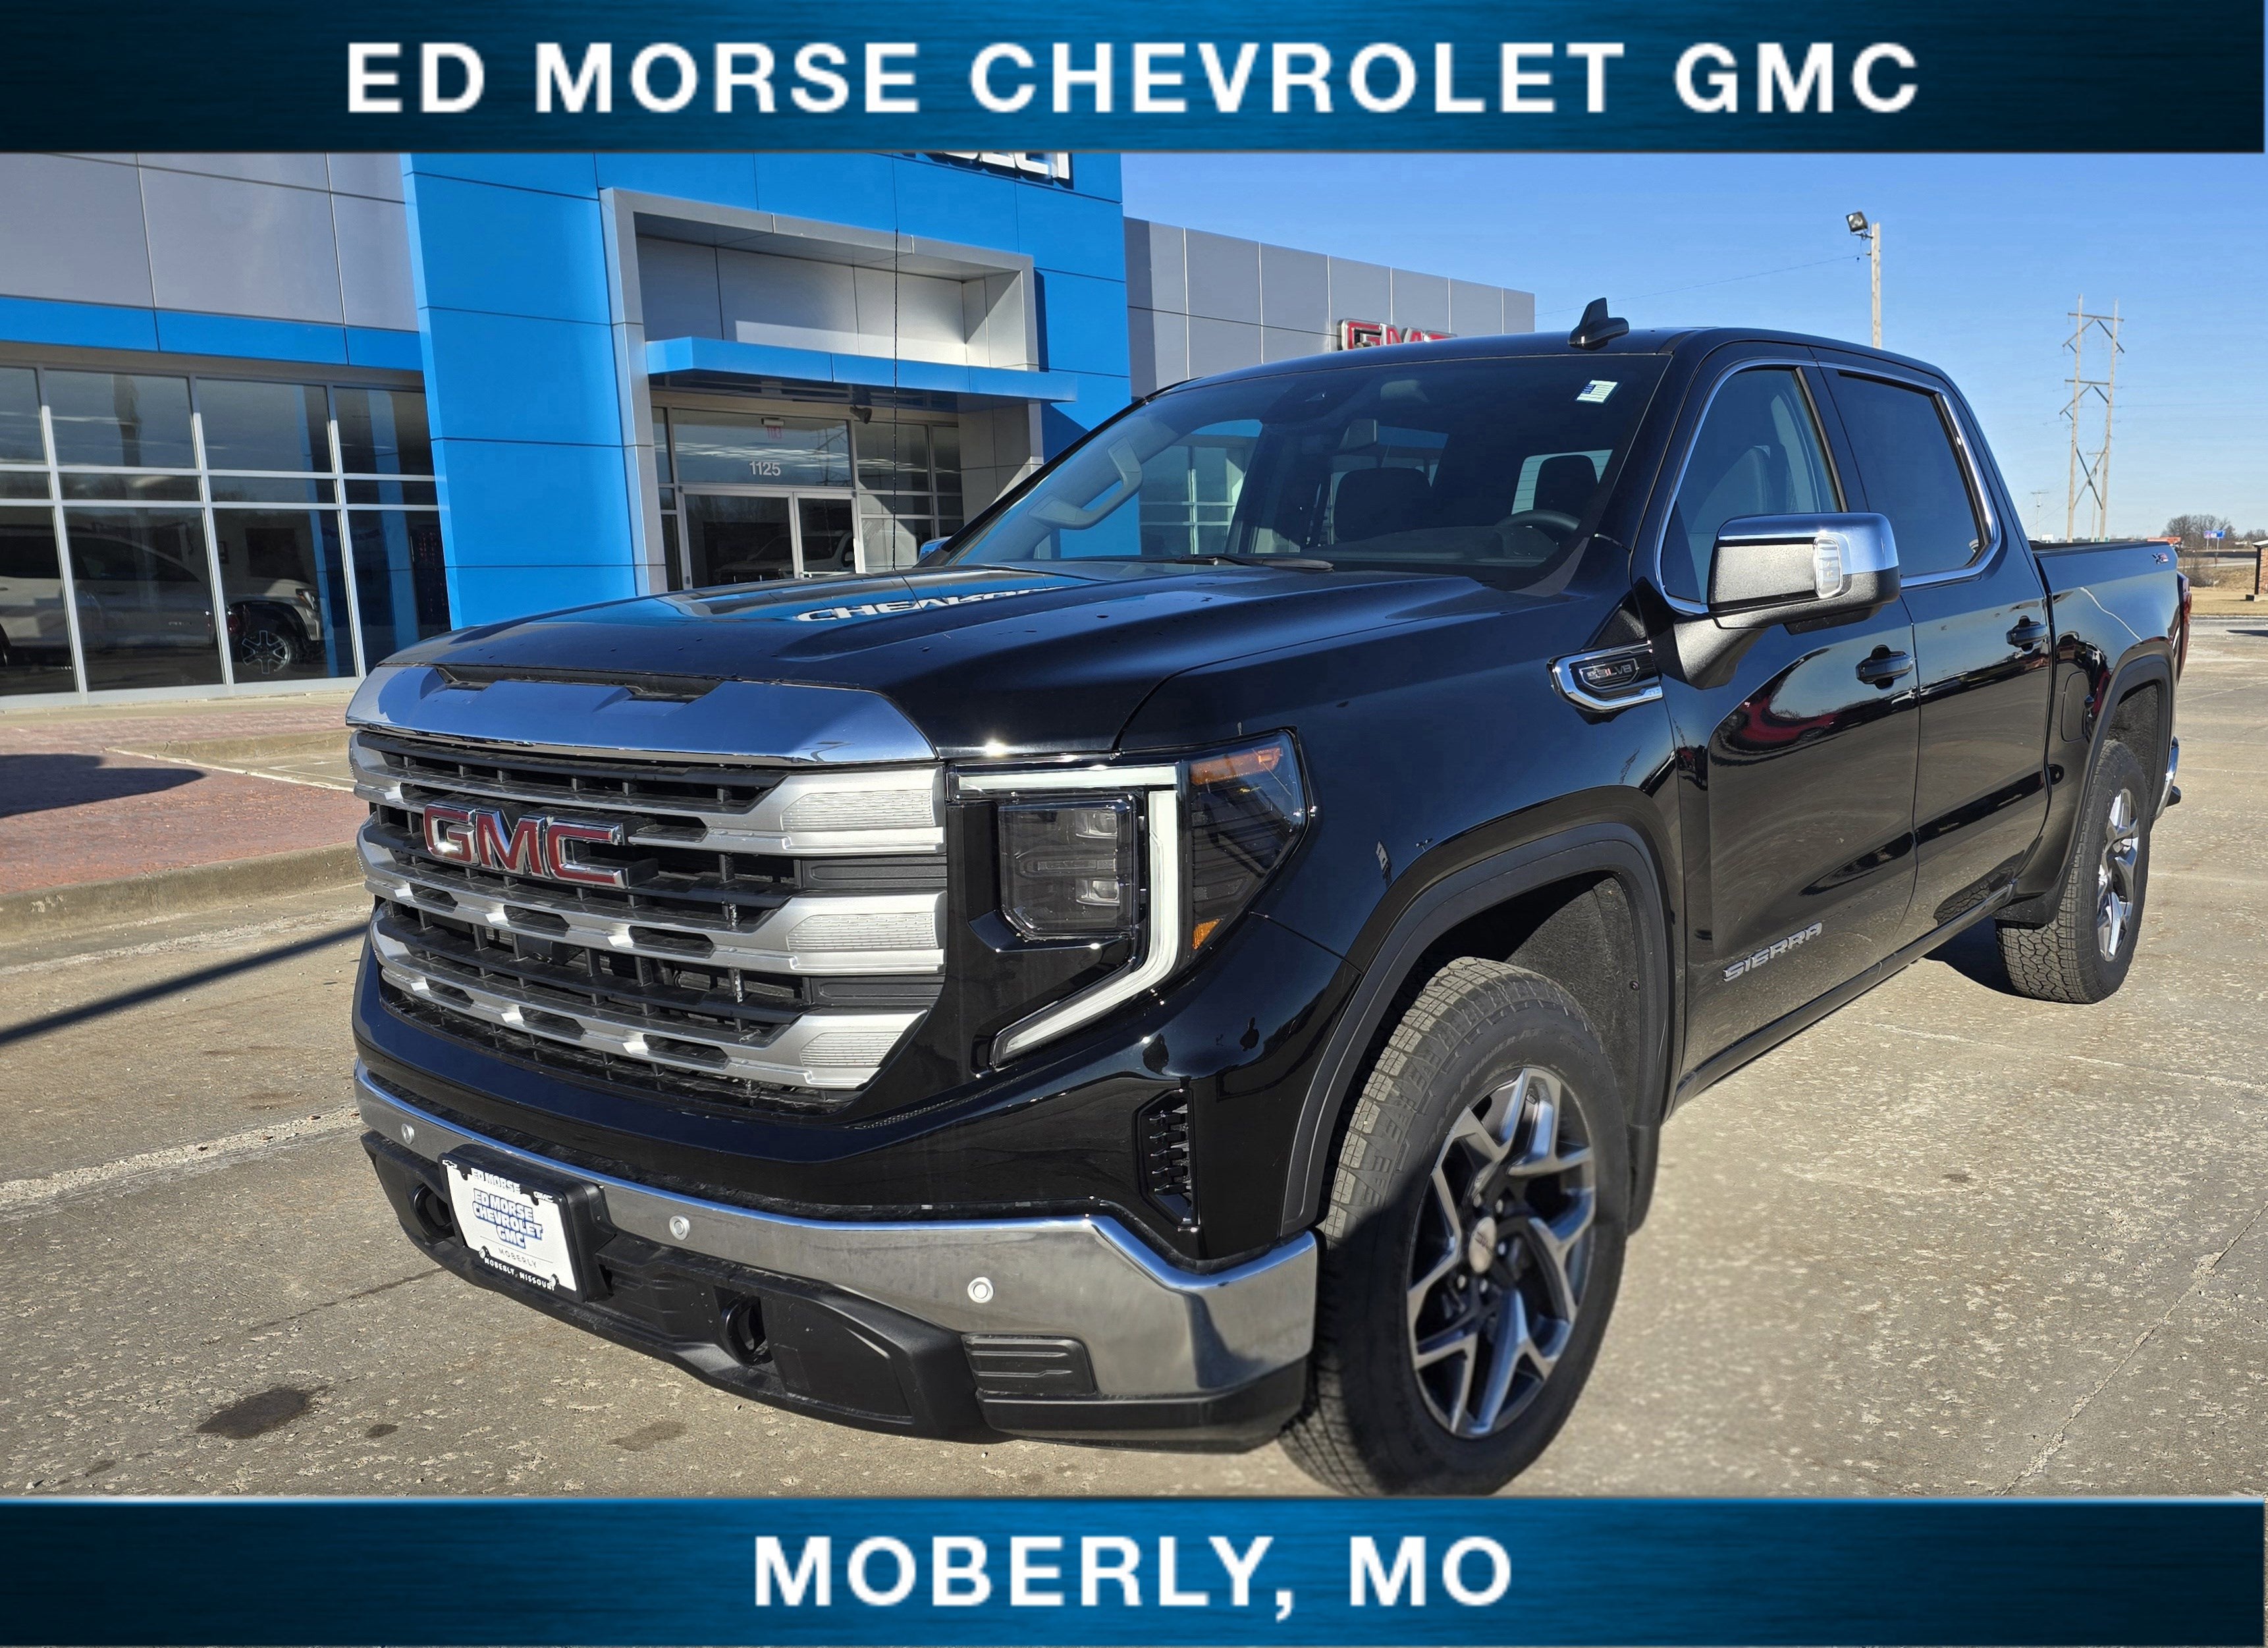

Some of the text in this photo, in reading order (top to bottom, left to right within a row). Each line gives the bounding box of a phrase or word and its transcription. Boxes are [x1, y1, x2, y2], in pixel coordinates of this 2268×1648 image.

[749, 461, 781, 476] 1125
[423, 804, 628, 889] GMC
[1723, 922, 1822, 982] SIERRA
[471, 1167, 522, 1194] ED MORSE
[473, 1188, 534, 1222] ED MORSE
[533, 1191, 554, 1203] GMC
[472, 1201, 543, 1240] CHEVROLET
[497, 1225, 526, 1249] GMC
[498, 1248, 537, 1268] MOBERLY
